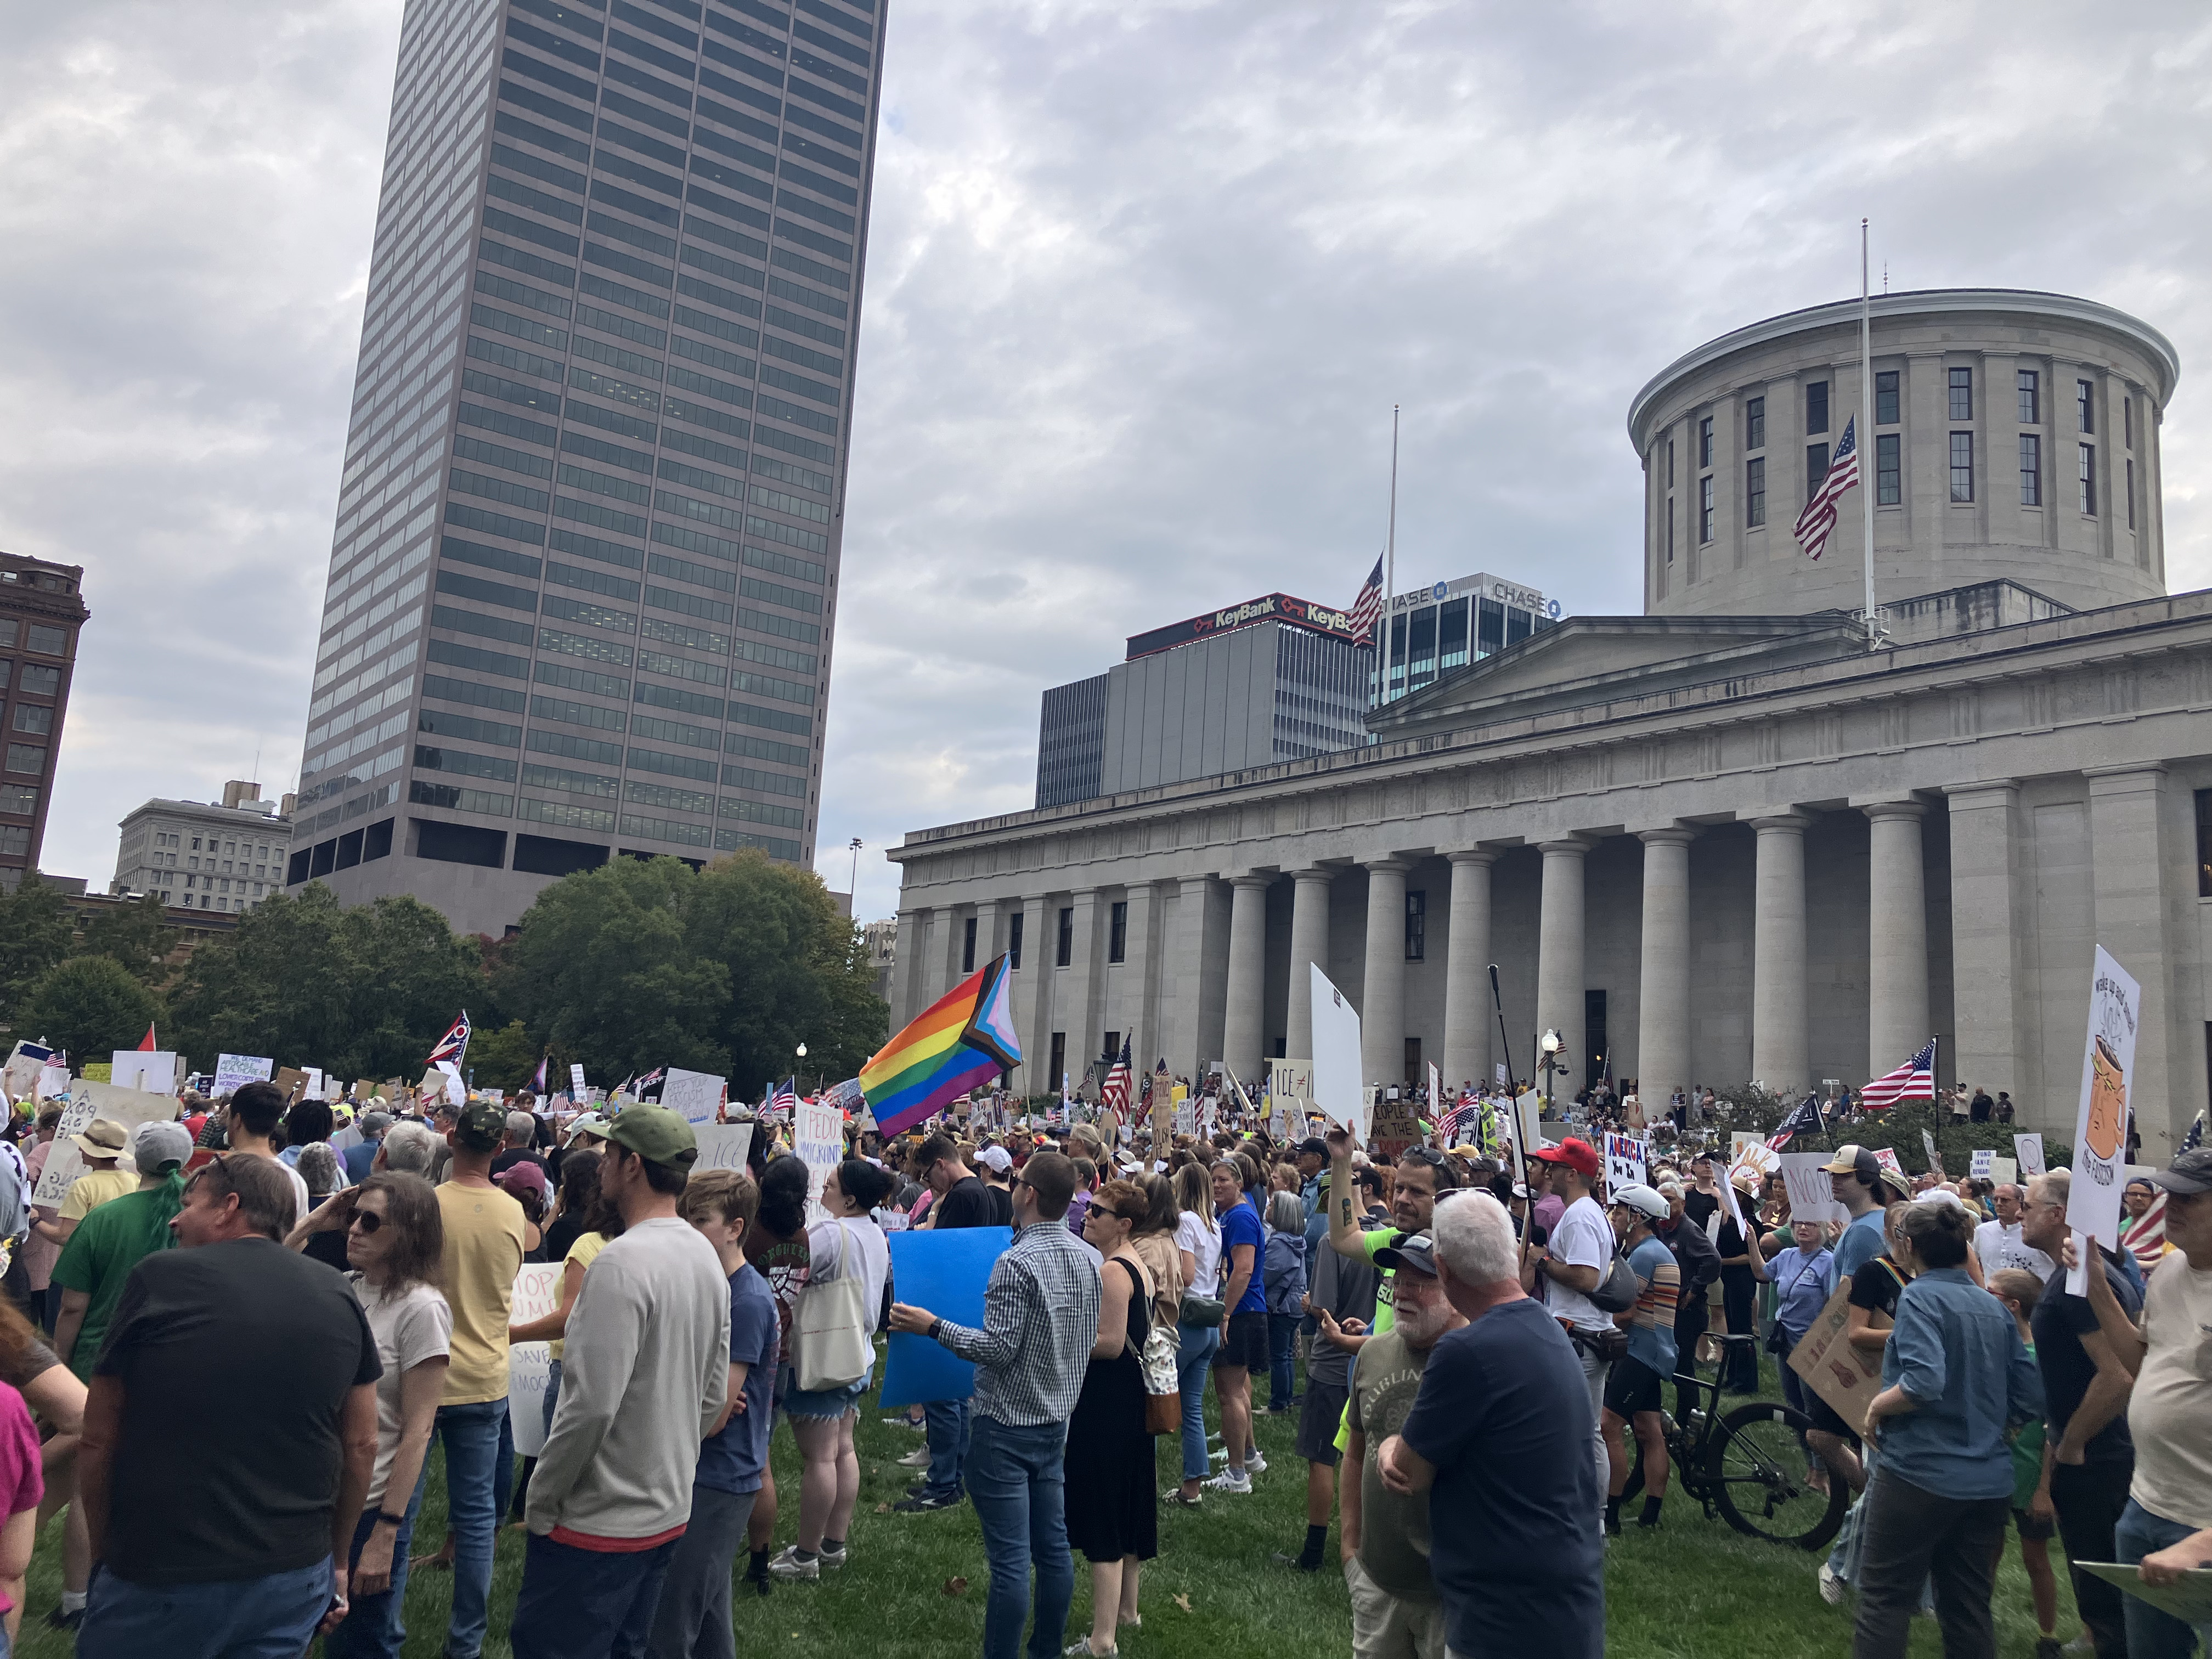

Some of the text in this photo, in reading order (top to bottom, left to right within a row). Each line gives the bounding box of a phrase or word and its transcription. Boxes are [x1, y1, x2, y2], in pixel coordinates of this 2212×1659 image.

[1382, 588, 1429, 612] HASE
[1495, 583, 1546, 613] CHASE
[1216, 597, 1276, 628] KeyBank
[219, 1064, 258, 1076] HEALTHCARE
[667, 1082, 686, 1096] KEEP
[1277, 1069, 1294, 1097] ICE
[669, 1088, 704, 1105] FASCISM
[1178, 1101, 1190, 1113] STOP
[1374, 1104, 1407, 1120] EOPLE
[1372, 1125, 1387, 1137] AVE
[1391, 1122, 1413, 1137] THE
[1788, 1166, 1819, 1205] NO
[1363, 1368, 1424, 1419] DUBLIN
